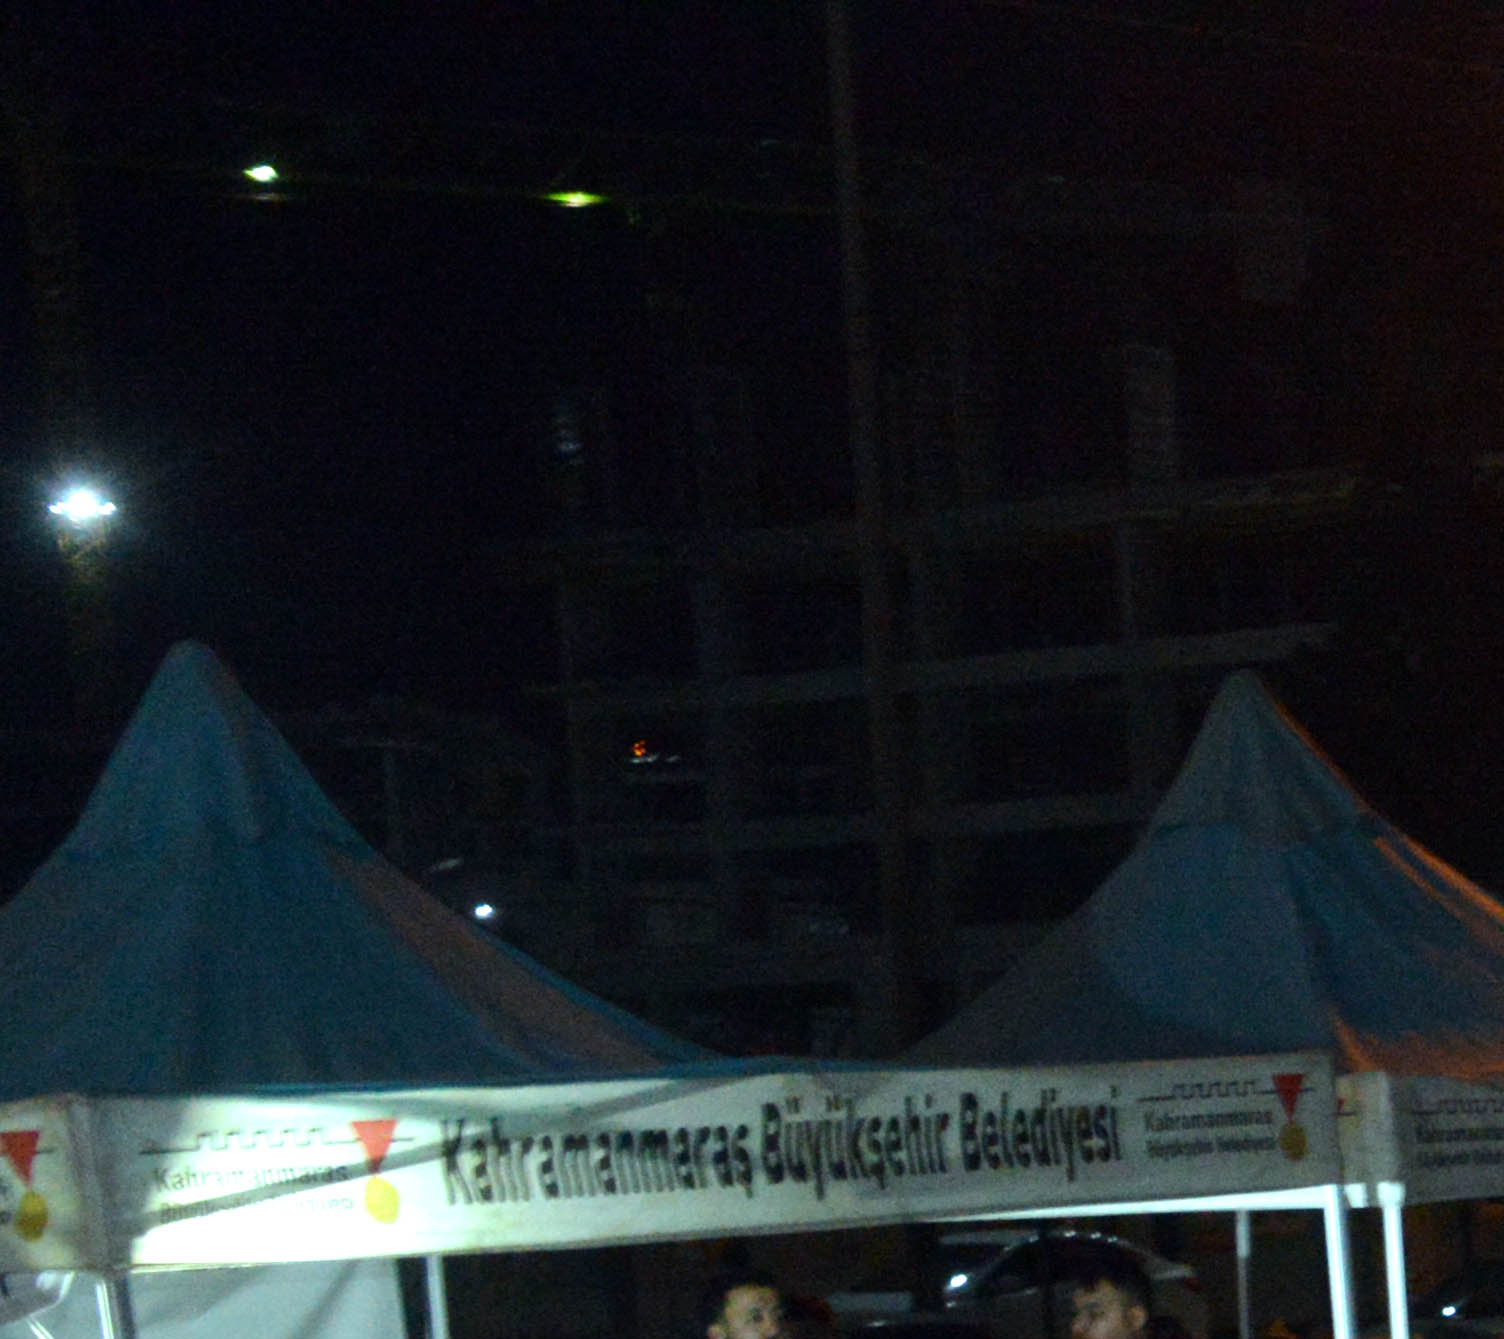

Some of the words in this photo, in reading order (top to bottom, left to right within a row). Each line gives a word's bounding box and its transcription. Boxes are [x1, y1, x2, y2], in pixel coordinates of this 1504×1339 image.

[440, 1117, 753, 1203] Kahramanmaraş
[761, 1096, 949, 1200] Büyükşehir
[960, 1086, 1121, 1182] Belediyesi
